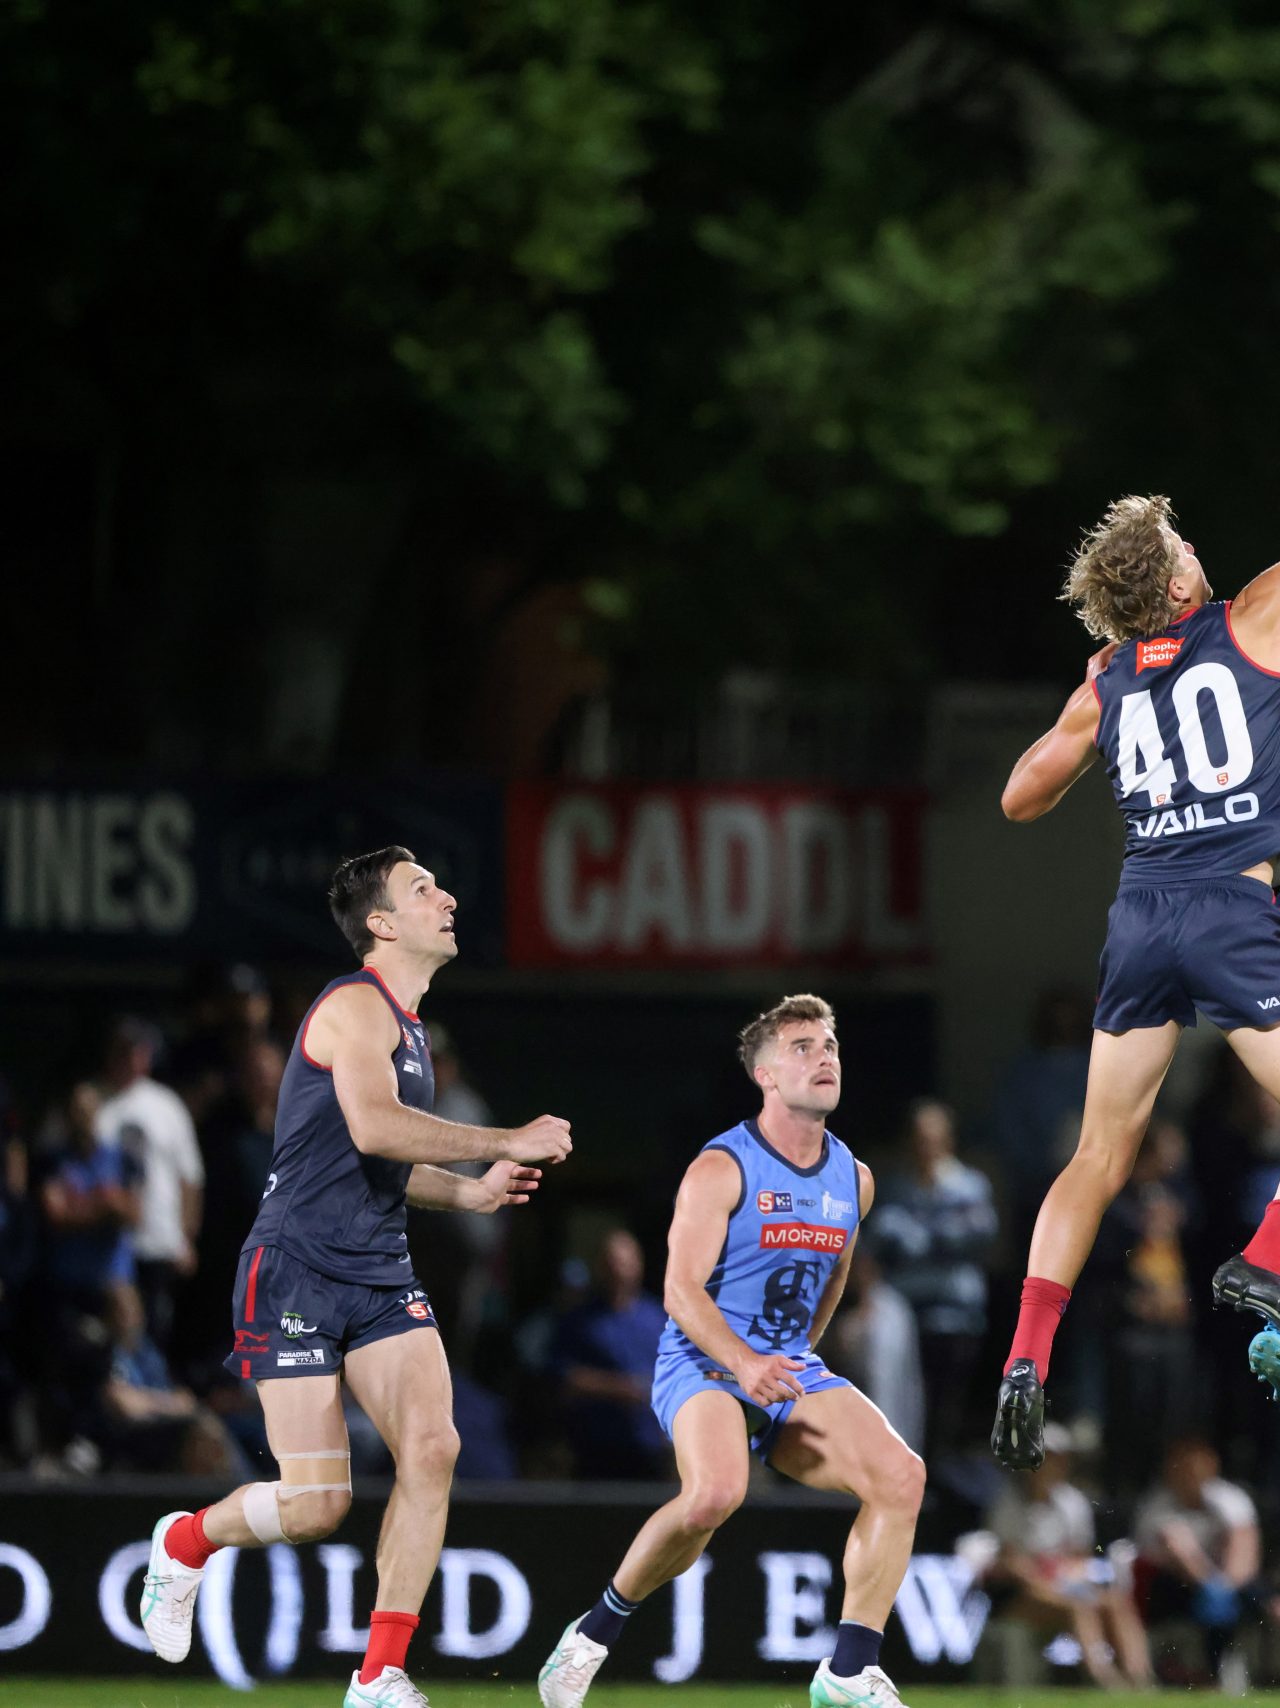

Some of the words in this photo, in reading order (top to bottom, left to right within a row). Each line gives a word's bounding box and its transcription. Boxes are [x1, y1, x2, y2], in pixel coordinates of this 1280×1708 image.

[1117, 662, 1254, 808] 40
[1128, 792, 1260, 838] VAILO
[764, 1228, 845, 1249] MORRIS
[280, 1317, 318, 1335] Milk
[279, 1351, 312, 1359] PARADISE
